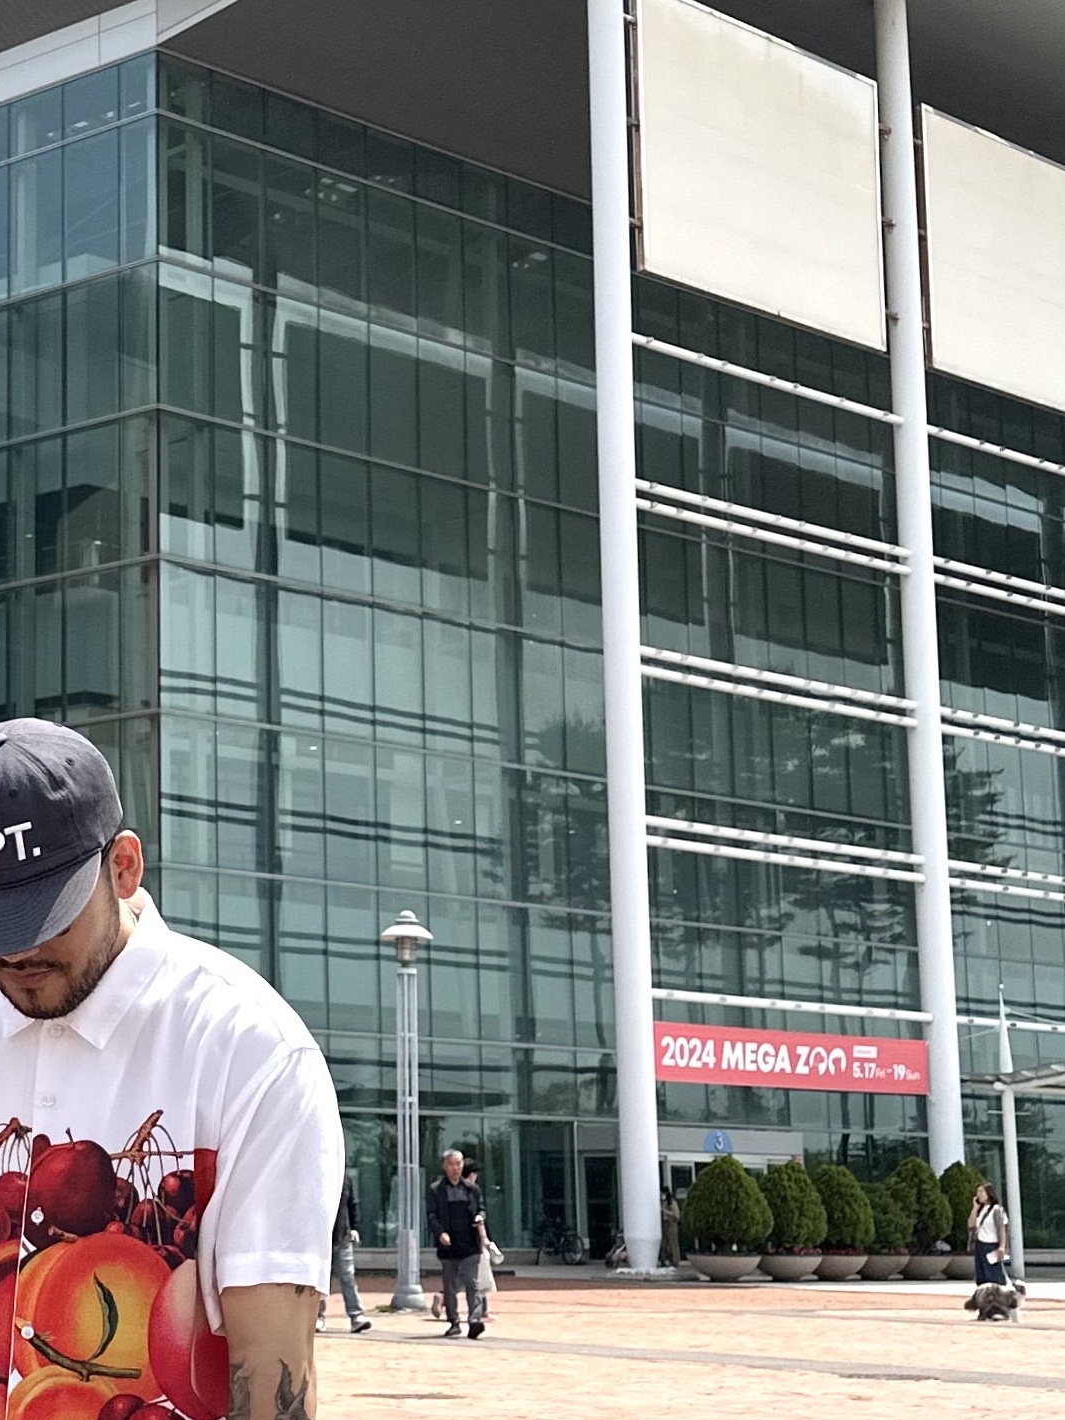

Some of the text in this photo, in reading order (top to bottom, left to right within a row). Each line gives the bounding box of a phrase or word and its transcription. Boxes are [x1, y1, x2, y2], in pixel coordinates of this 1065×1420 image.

[661, 1036, 847, 1076] 2024 MEGA ZOO
[715, 1130, 724, 1151] 3
